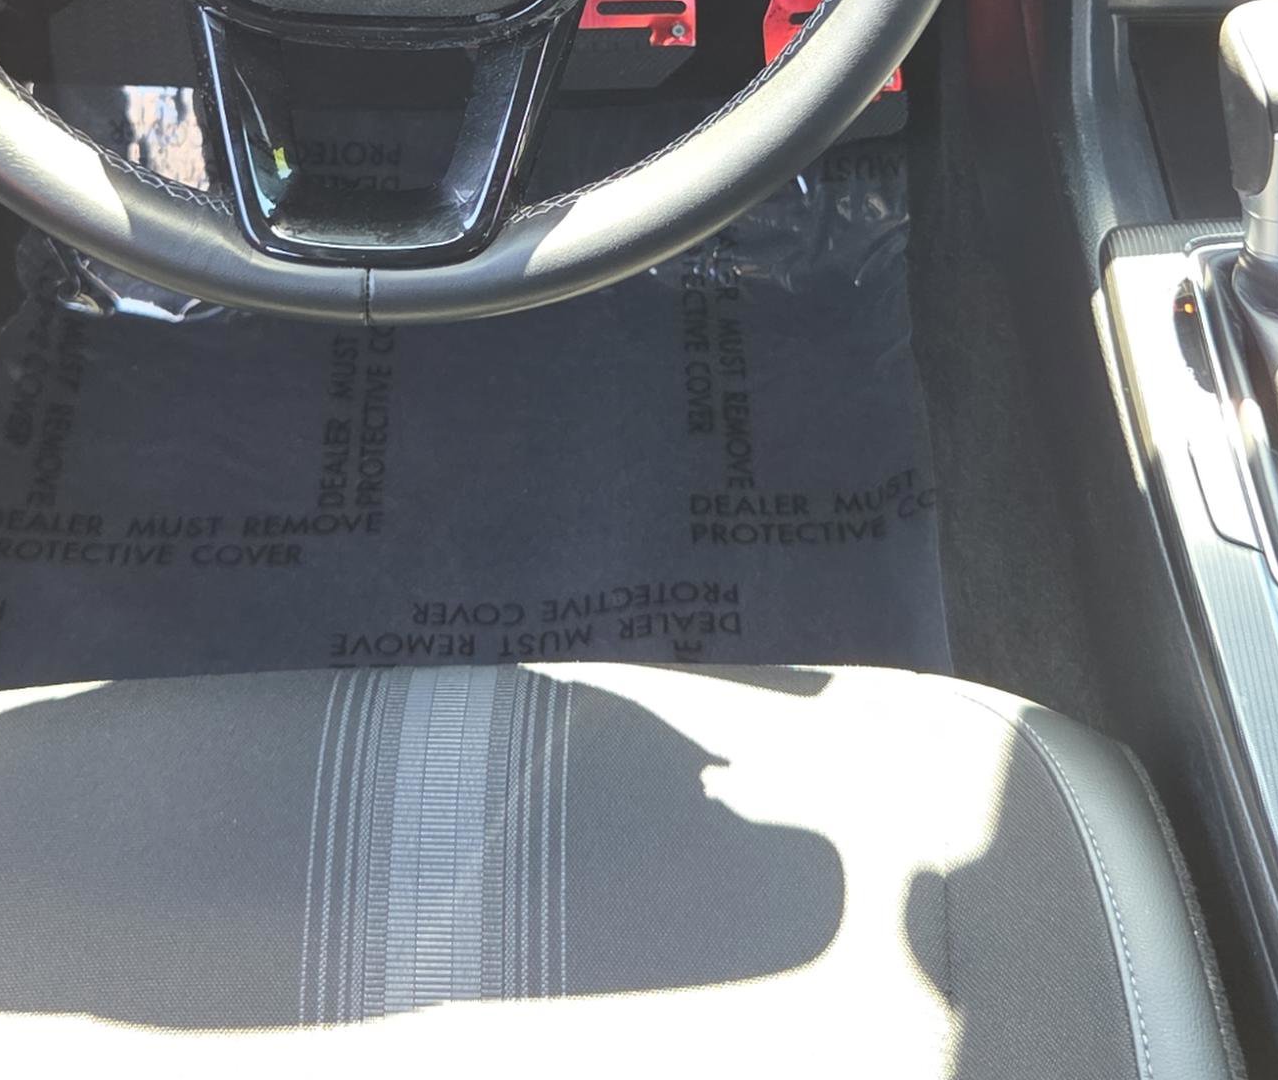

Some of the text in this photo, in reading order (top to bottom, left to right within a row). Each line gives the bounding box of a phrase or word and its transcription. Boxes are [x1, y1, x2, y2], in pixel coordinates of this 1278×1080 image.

[717, 316, 748, 381] MUST
[317, 330, 361, 509] DEALER MUST
[683, 359, 716, 436] COVER
[354, 363, 393, 509] PROTECTIVE
[722, 390, 756, 491] REMOVE
[689, 467, 919, 519] DEALER MUST
[124, 514, 224, 539] MUST
[241, 510, 386, 538] REMOVE
[689, 514, 889, 547] PROTECTIVE
[189, 542, 304, 567] COVER
[411, 579, 740, 629] PROTECTIVE COVER
[328, 609, 743, 660] DEALER MUST REMOVE
